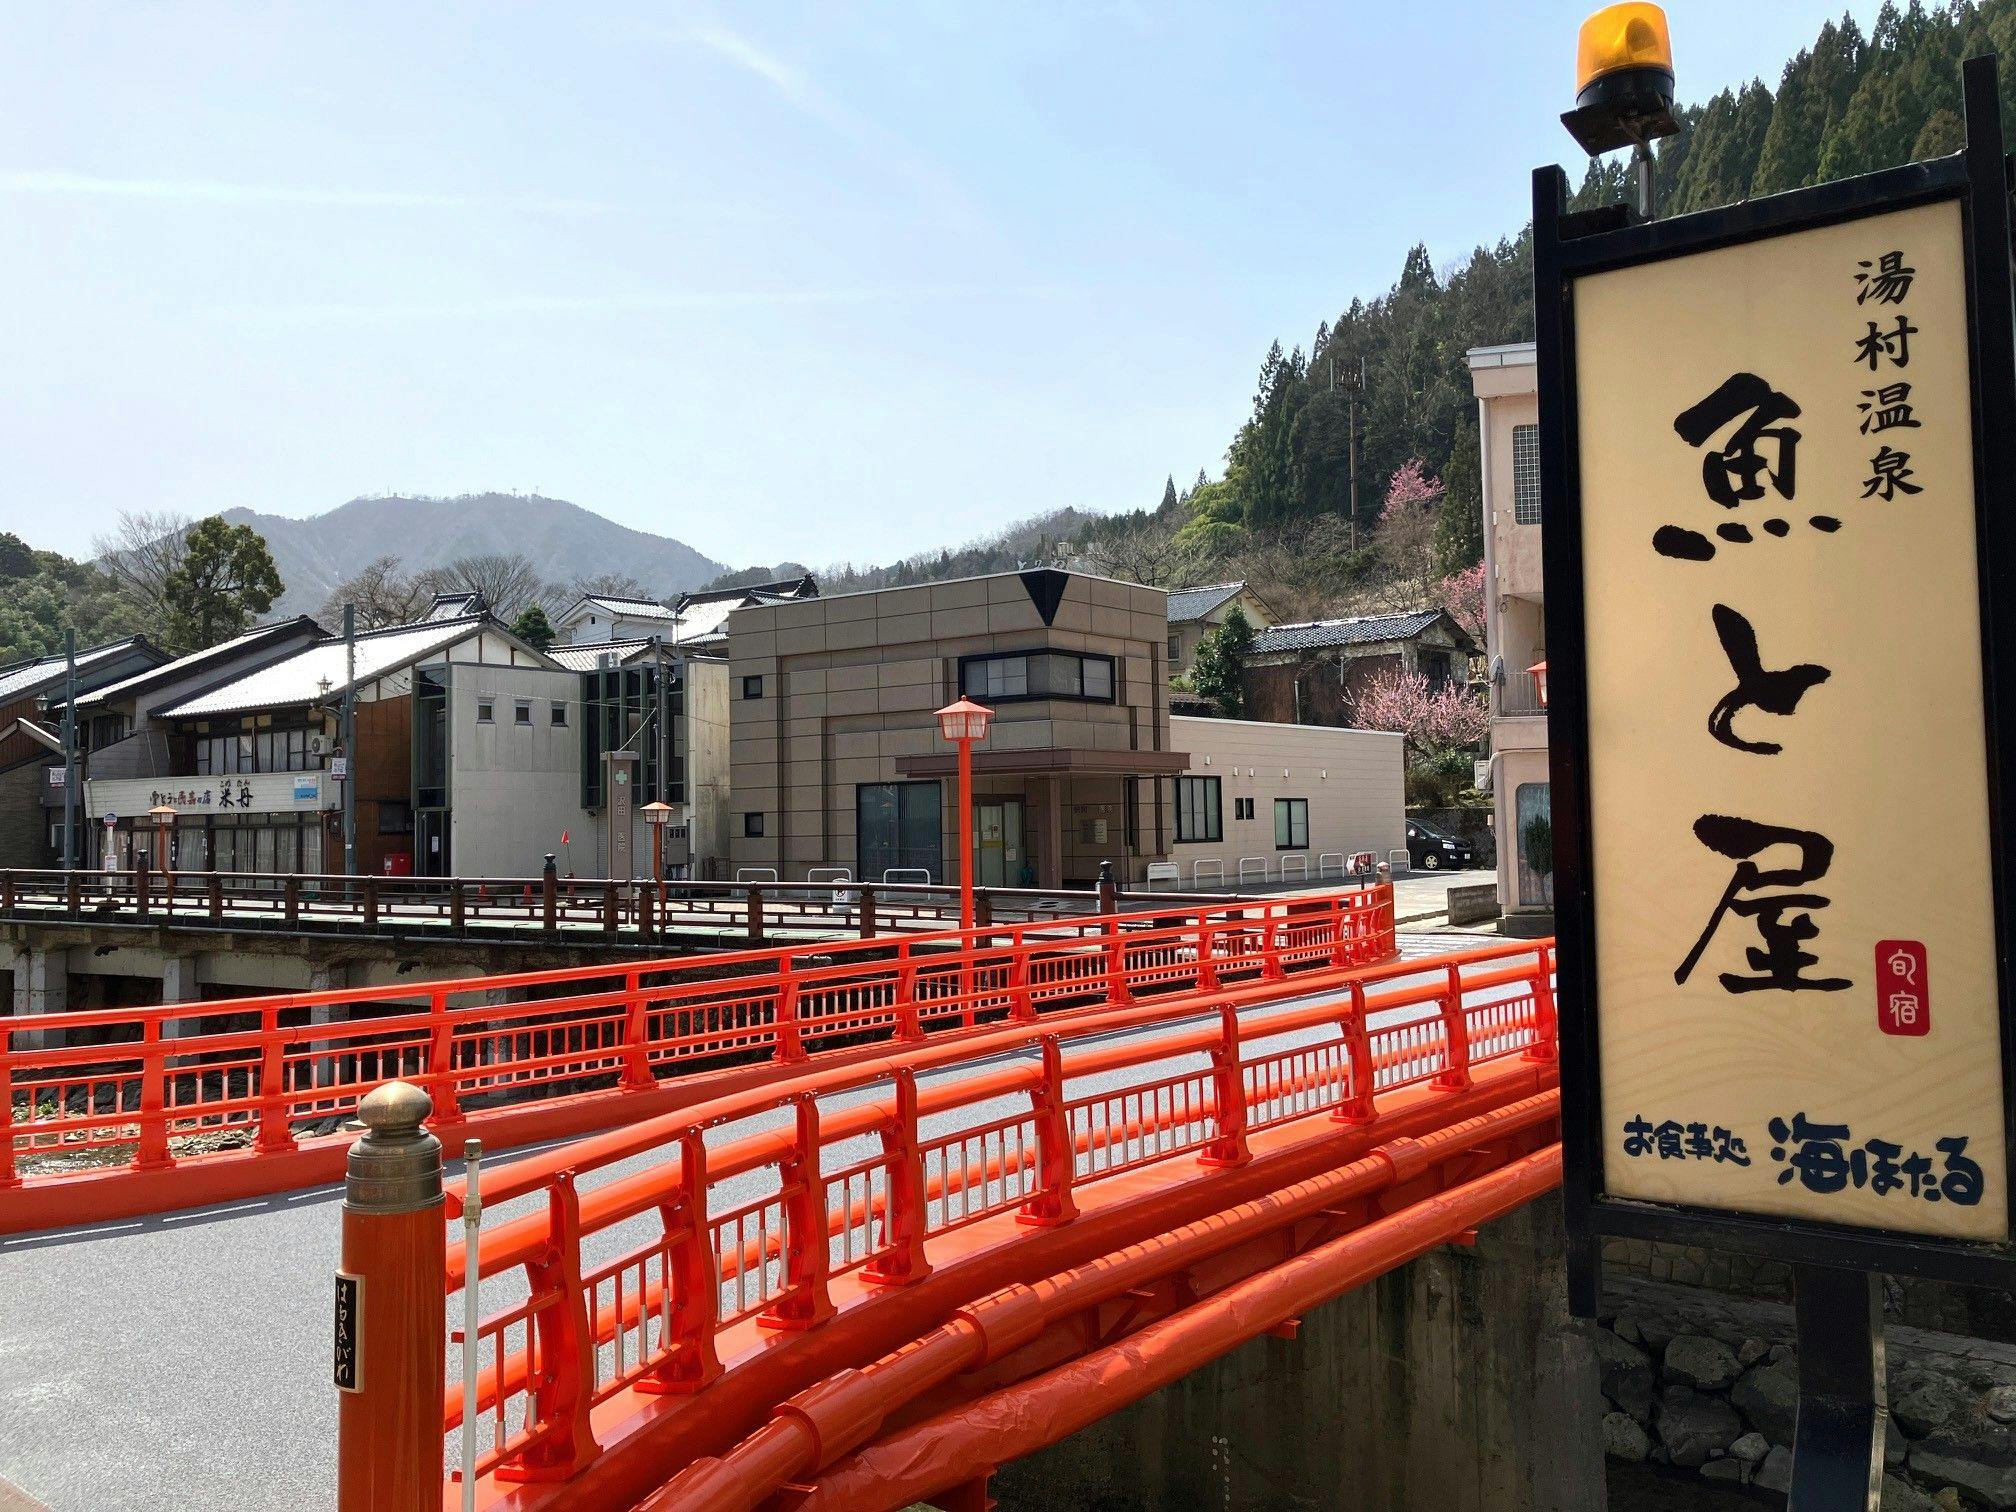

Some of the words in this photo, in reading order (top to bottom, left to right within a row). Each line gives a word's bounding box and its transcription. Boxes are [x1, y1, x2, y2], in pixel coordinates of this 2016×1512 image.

[1854, 251, 1923, 502] 湯村温泉
[1652, 373, 1853, 994] 魚と屋
[1887, 948, 1918, 1028] 旬宿
[1623, 1113, 1752, 1168] お食事処
[1767, 1111, 1985, 1207] 海ほたる
